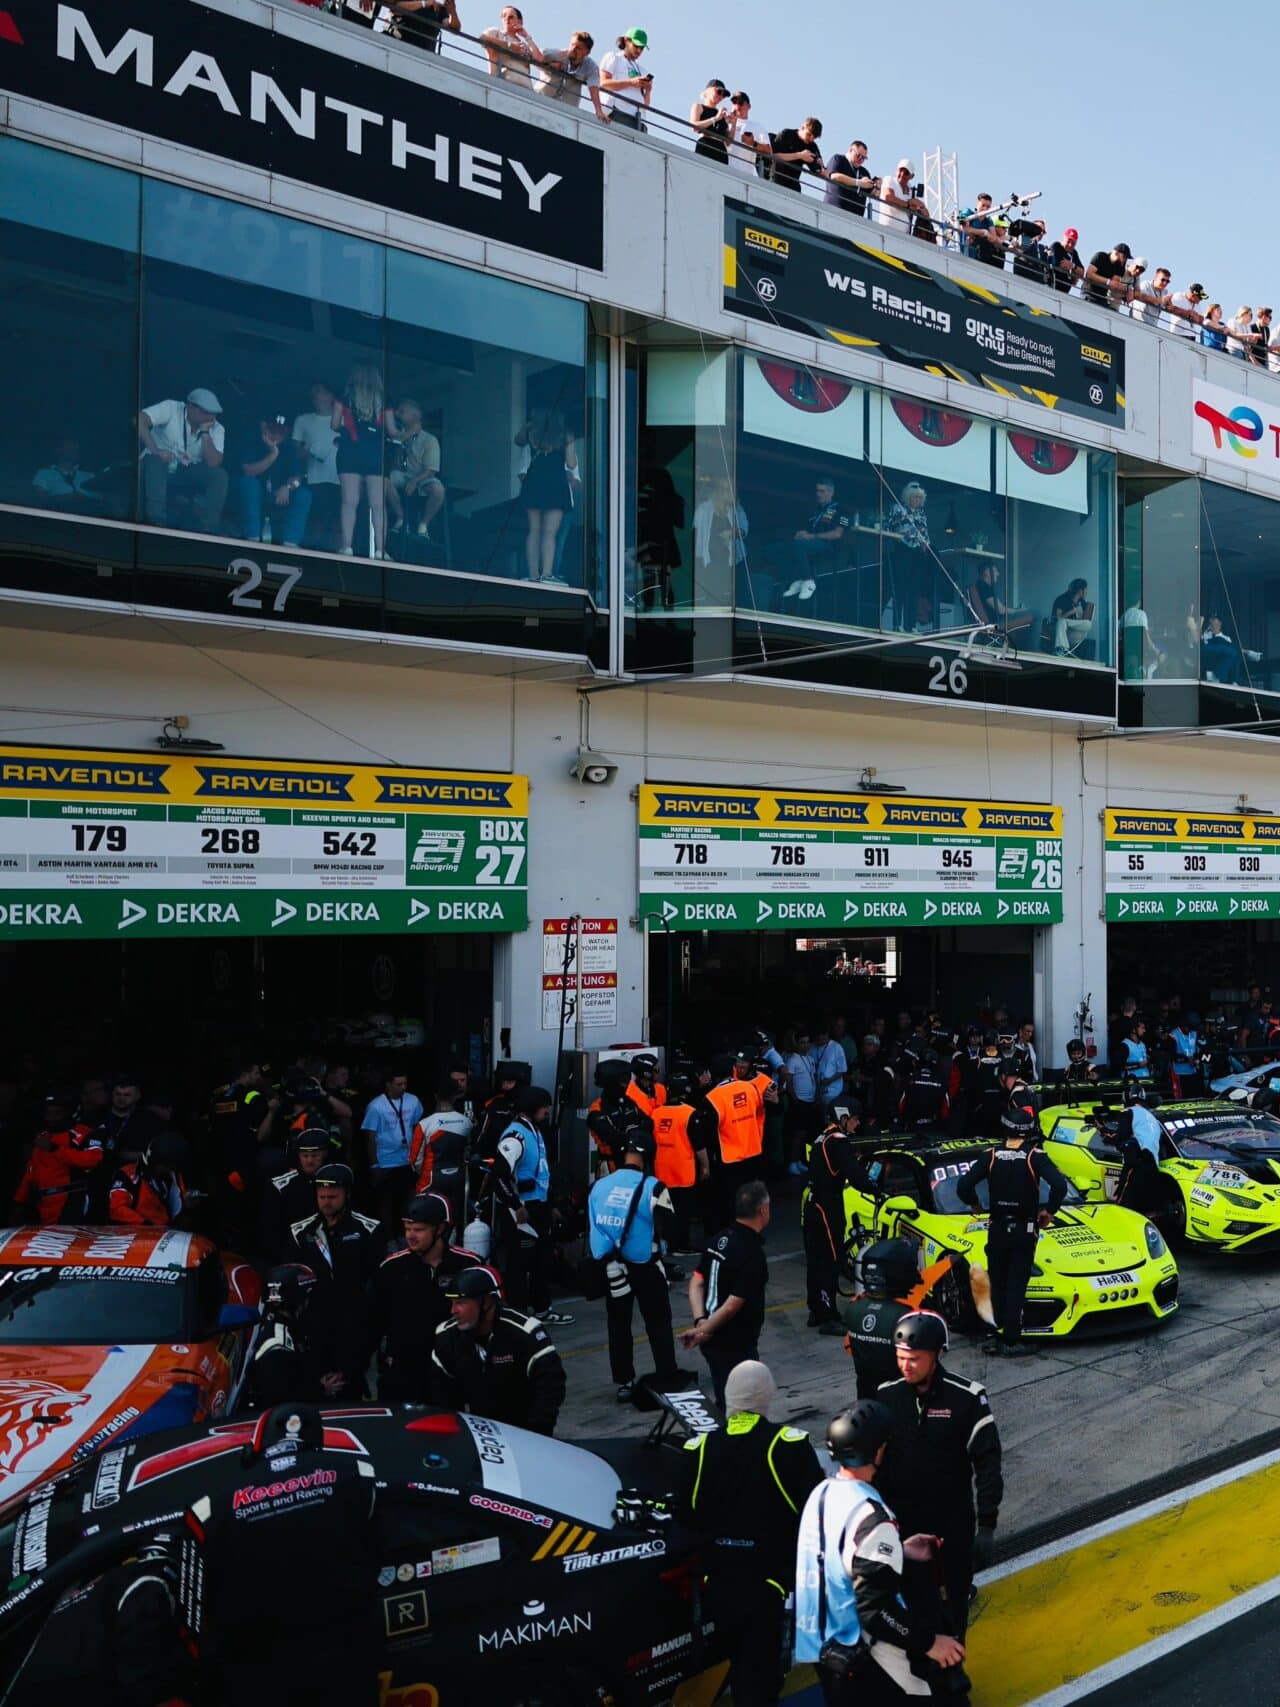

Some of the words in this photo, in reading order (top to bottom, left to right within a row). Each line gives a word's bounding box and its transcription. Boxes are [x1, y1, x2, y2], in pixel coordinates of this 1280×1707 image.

[56, 3, 563, 213] MANTHEY
[747, 231, 774, 247] Giti
[757, 280, 775, 298] ZF
[824, 268, 866, 298] WS
[872, 285, 951, 334] Racing
[966, 317, 1005, 342] girls
[1006, 331, 1028, 348] Ready
[1028, 338, 1037, 350] to
[1038, 340, 1055, 357] rock
[1006, 345, 1019, 356] the
[1020, 348, 1041, 364] Green
[1041, 353, 1056, 369] Hell
[1082, 346, 1101, 360] Giti
[227, 558, 303, 612] 27
[928, 655, 969, 695] 26
[2, 764, 154, 786] RAVENOL
[211, 775, 341, 795] RAVENOL
[389, 783, 500, 801] RAVENOL
[85, 806, 137, 817] MOTORSPORT
[664, 798, 752, 815] RAVENOL
[783, 804, 861, 820] RAVENOL
[890, 808, 960, 824] RAVENOL
[985, 813, 1050, 828] RAVENOL
[480, 820, 525, 841] BOX
[1119, 821, 1173, 832] RAVENOL
[1192, 823, 1241, 834] RAVENOL
[71, 824, 127, 852] 179
[201, 828, 260, 854] 268
[323, 831, 377, 856] 542
[674, 843, 708, 865] 718
[770, 845, 805, 866] 786
[1036, 840, 1062, 857] BOX
[38, 860, 62, 868] ASTON
[64, 860, 92, 868] MARTIN
[93, 860, 126, 869] VANTAGE
[127, 861, 143, 869] AMR
[207, 862, 232, 870] TOYOTA
[233, 862, 255, 870] SUPRA
[475, 845, 526, 884] 27
[864, 848, 889, 867] 911
[942, 849, 973, 868] 945
[1128, 854, 1145, 871] 55
[1184, 855, 1206, 872] 303
[1239, 857, 1260, 872] 830
[313, 863, 329, 871] BMW
[410, 862, 459, 873] nürburgring
[1031, 859, 1062, 889] 26
[157, 904, 241, 925] DEKRA
[306, 902, 381, 922] DEKRA
[438, 902, 505, 920] DEKRA
[684, 904, 737, 921] DEKRA
[778, 903, 826, 919] DEKRA
[863, 902, 908, 918] DEKRA
[941, 901, 982, 917] DEKRA
[1012, 899, 1050, 916] DEKRA
[1132, 900, 1164, 914] DEKRA
[1188, 900, 1218, 914] DEKRA
[1242, 899, 1269, 913] DEKRA
[1214, 1114, 1247, 1122] TURISMO
[1211, 1168, 1241, 1182] 786
[595, 1214, 628, 1228] MEDI
[1057, 1234, 1103, 1247] NUMMER
[58, 1265, 109, 1276] GRAN
[110, 1266, 180, 1281] TURISMO
[1097, 1275, 1122, 1287] H&R
[232, 1468, 337, 1510] Keeevin
[235, 1500, 271, 1520] Sports
[272, 1494, 295, 1507] and
[296, 1485, 334, 1502] Racing
[470, 1495, 554, 1529] GOODRIDGE
[478, 1610, 593, 1654] MAKIMAN
